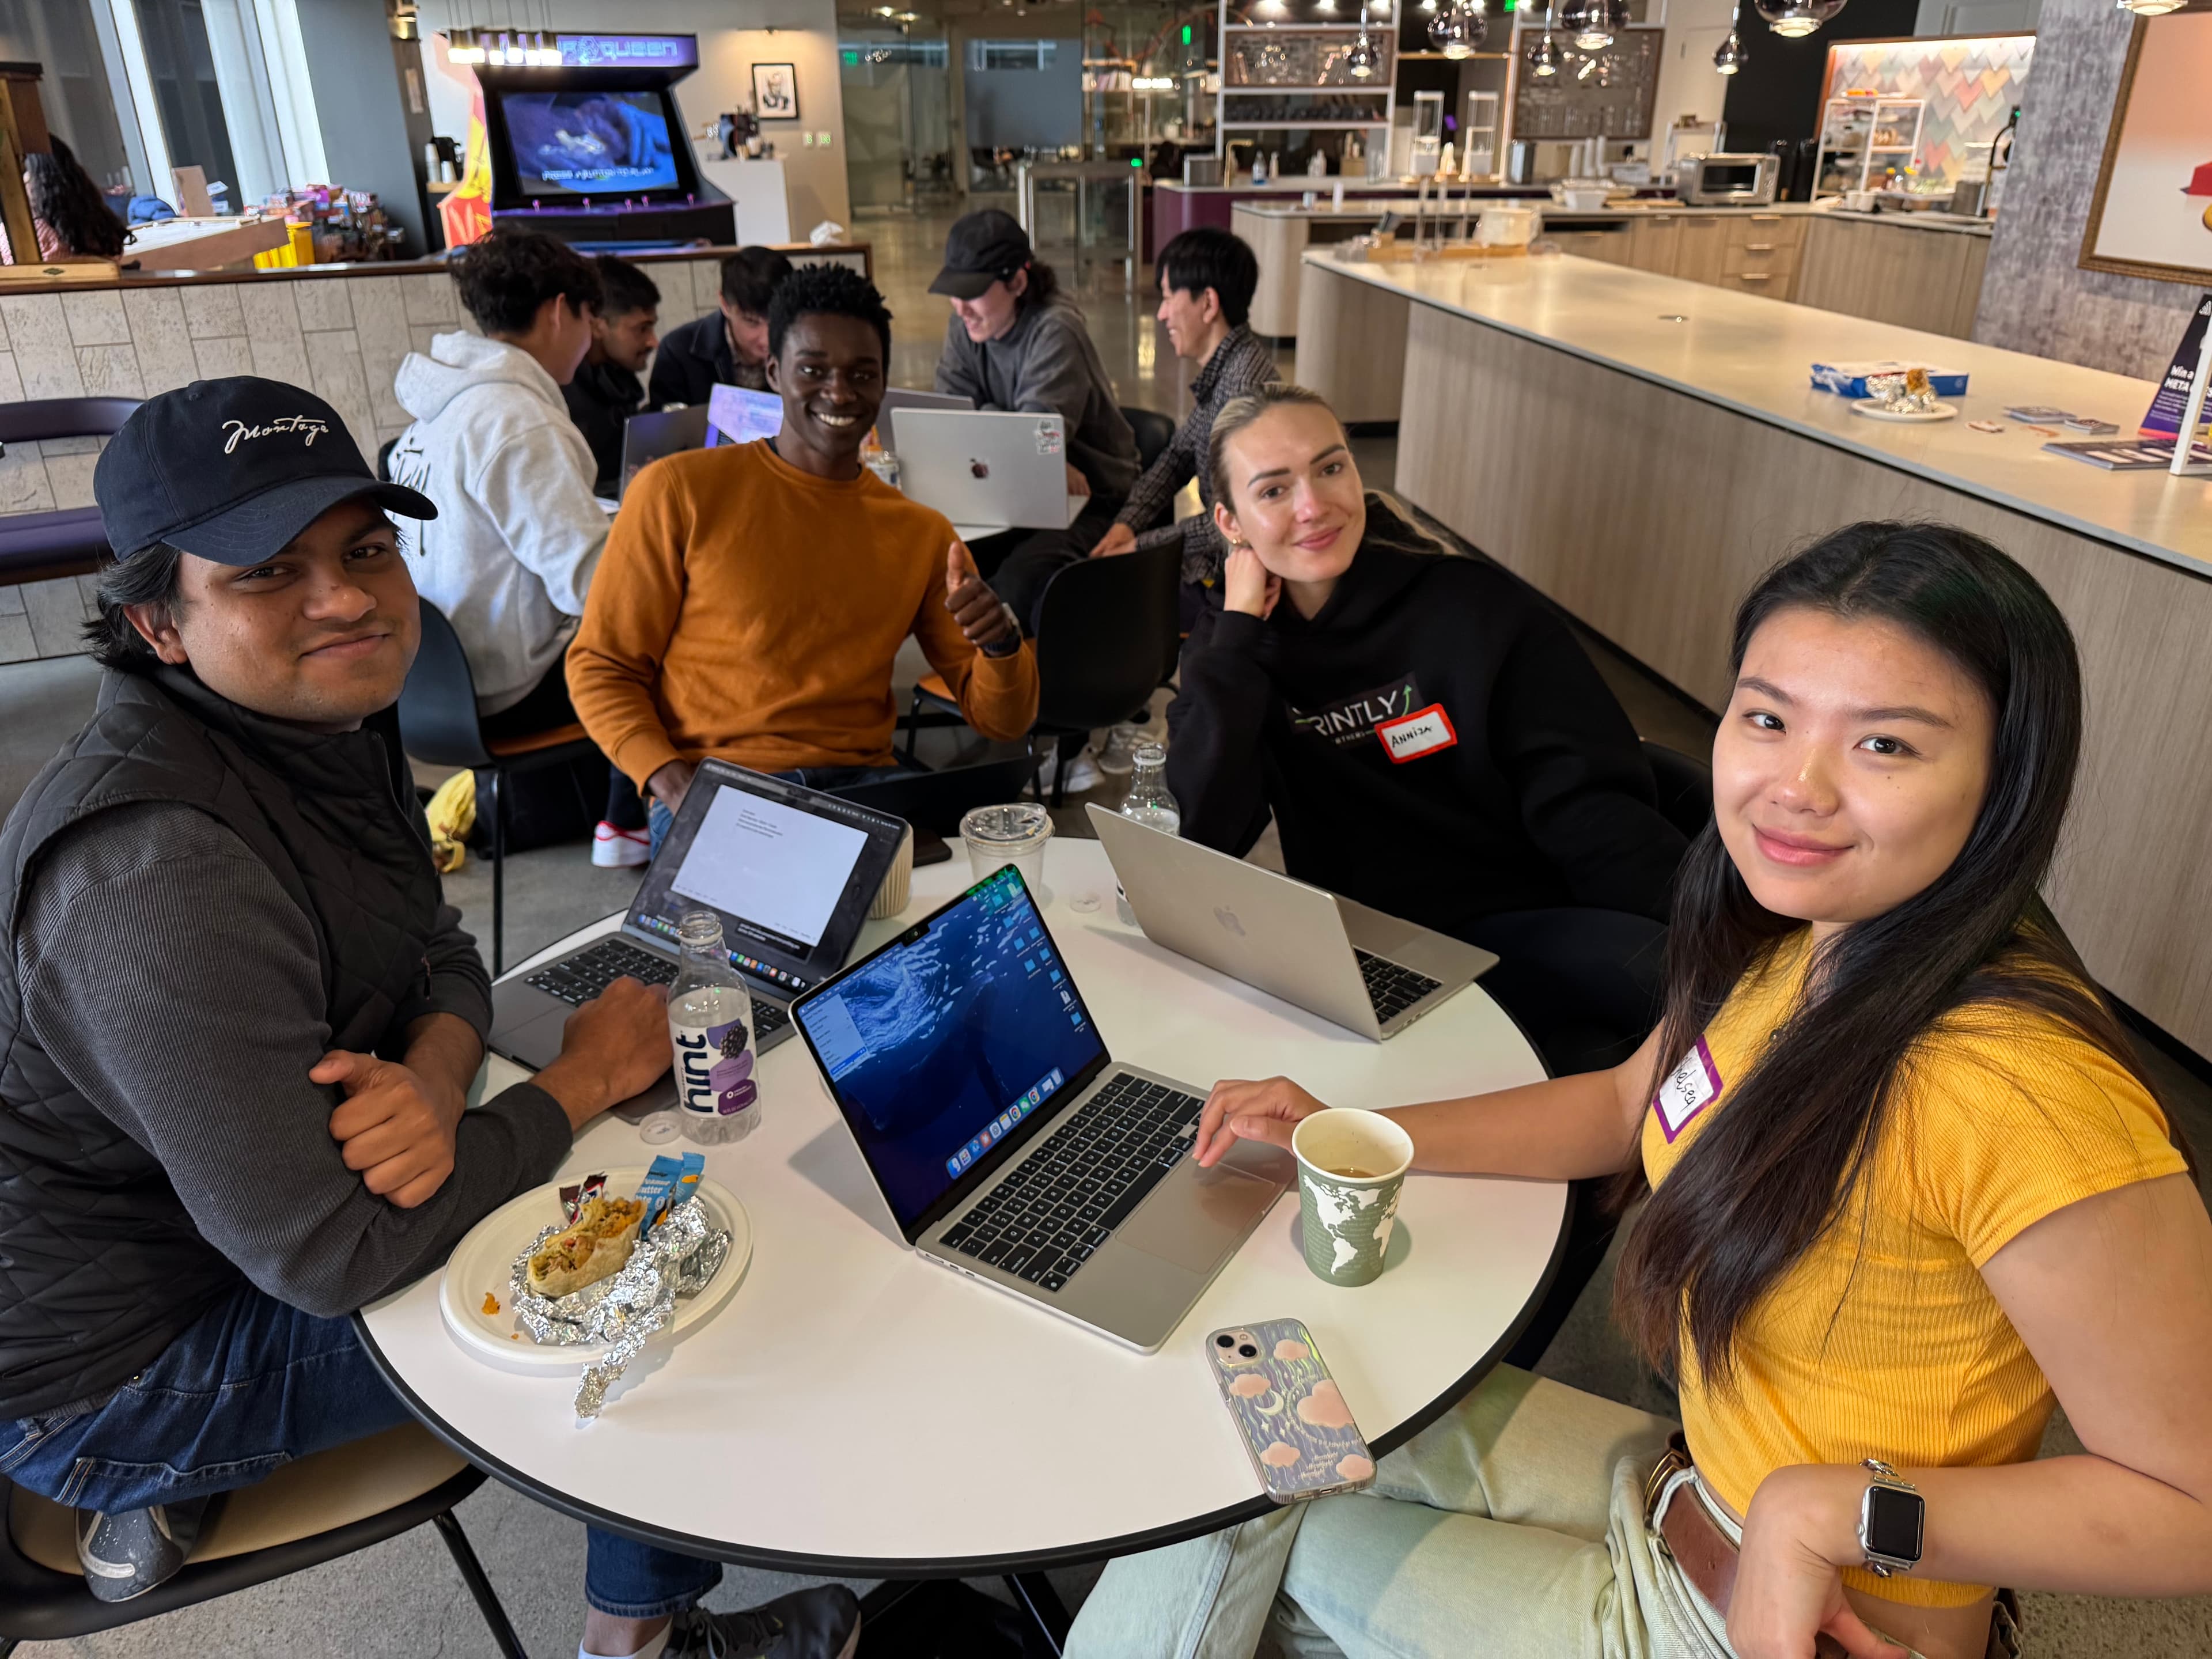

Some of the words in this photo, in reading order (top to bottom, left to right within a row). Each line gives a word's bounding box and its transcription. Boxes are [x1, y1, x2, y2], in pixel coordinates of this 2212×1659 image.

[1295, 690, 1397, 736] RINTLY
[676, 1034, 714, 1113] hint
[1672, 1056, 1696, 1112] helsea
